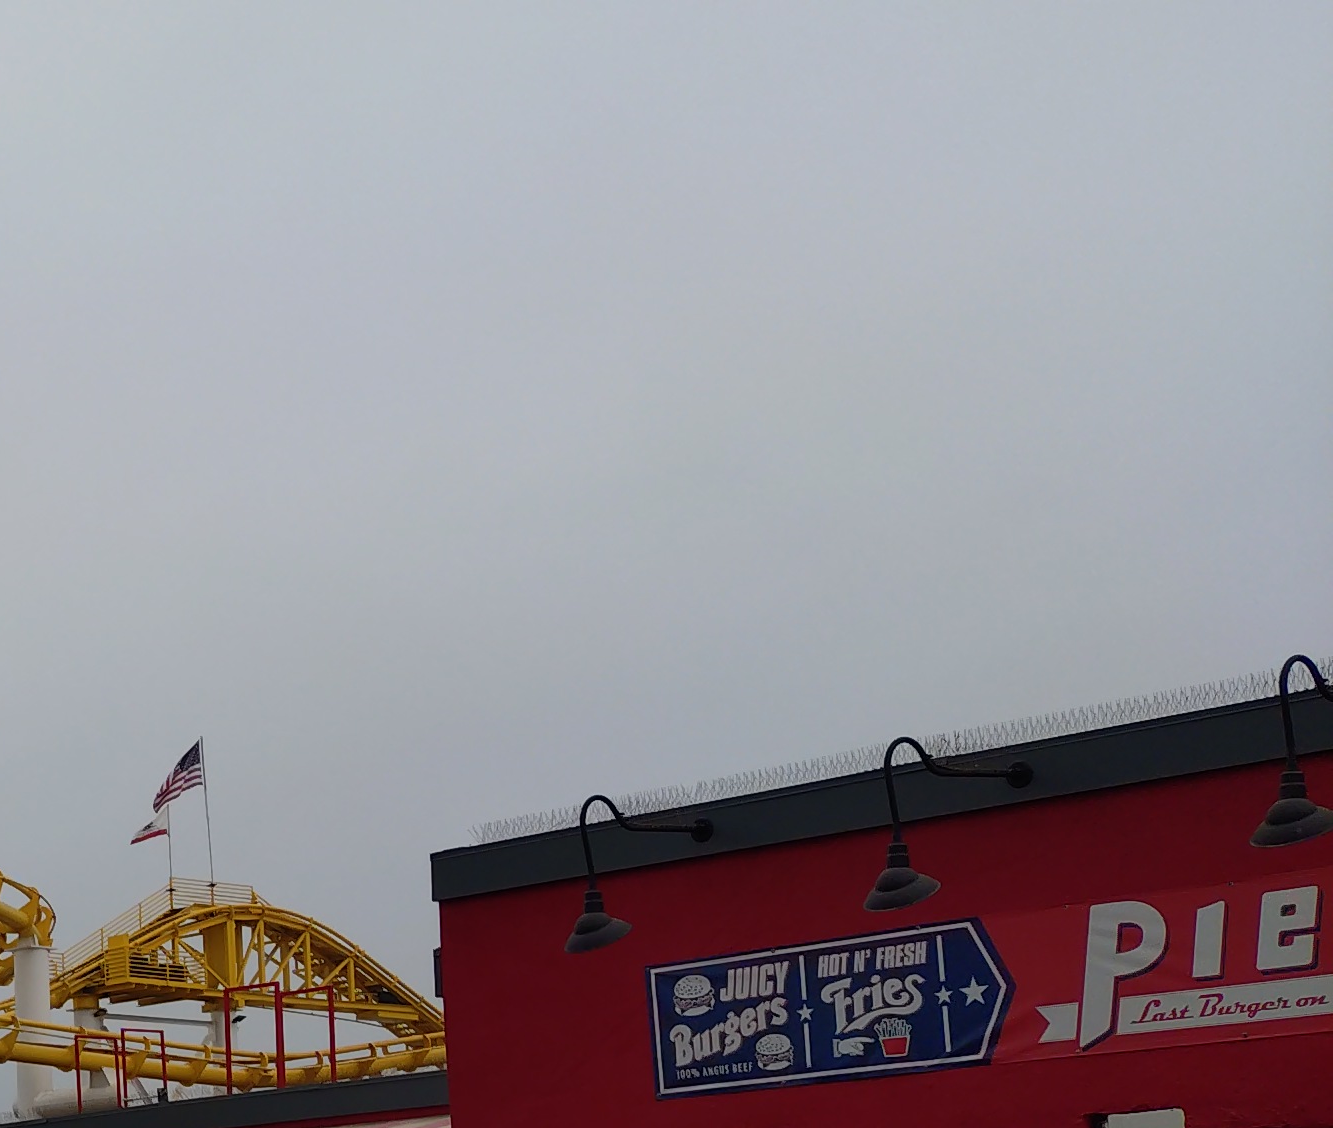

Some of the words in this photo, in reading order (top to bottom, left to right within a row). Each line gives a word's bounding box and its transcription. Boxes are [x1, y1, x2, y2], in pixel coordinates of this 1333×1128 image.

[817, 952, 850, 979] HOT
[875, 940, 929, 970] FRESH
[719, 960, 790, 1003] JUICY
[820, 973, 927, 1035] Fries
[1129, 999, 1194, 1025] Last
[1198, 992, 1292, 1019] Burger
[1295, 994, 1330, 1007] on
[669, 996, 789, 1067] Burgers
[676, 1065, 701, 1080] 100%
[702, 1062, 731, 1079] ANGUS
[732, 1060, 754, 1075] BEEF
